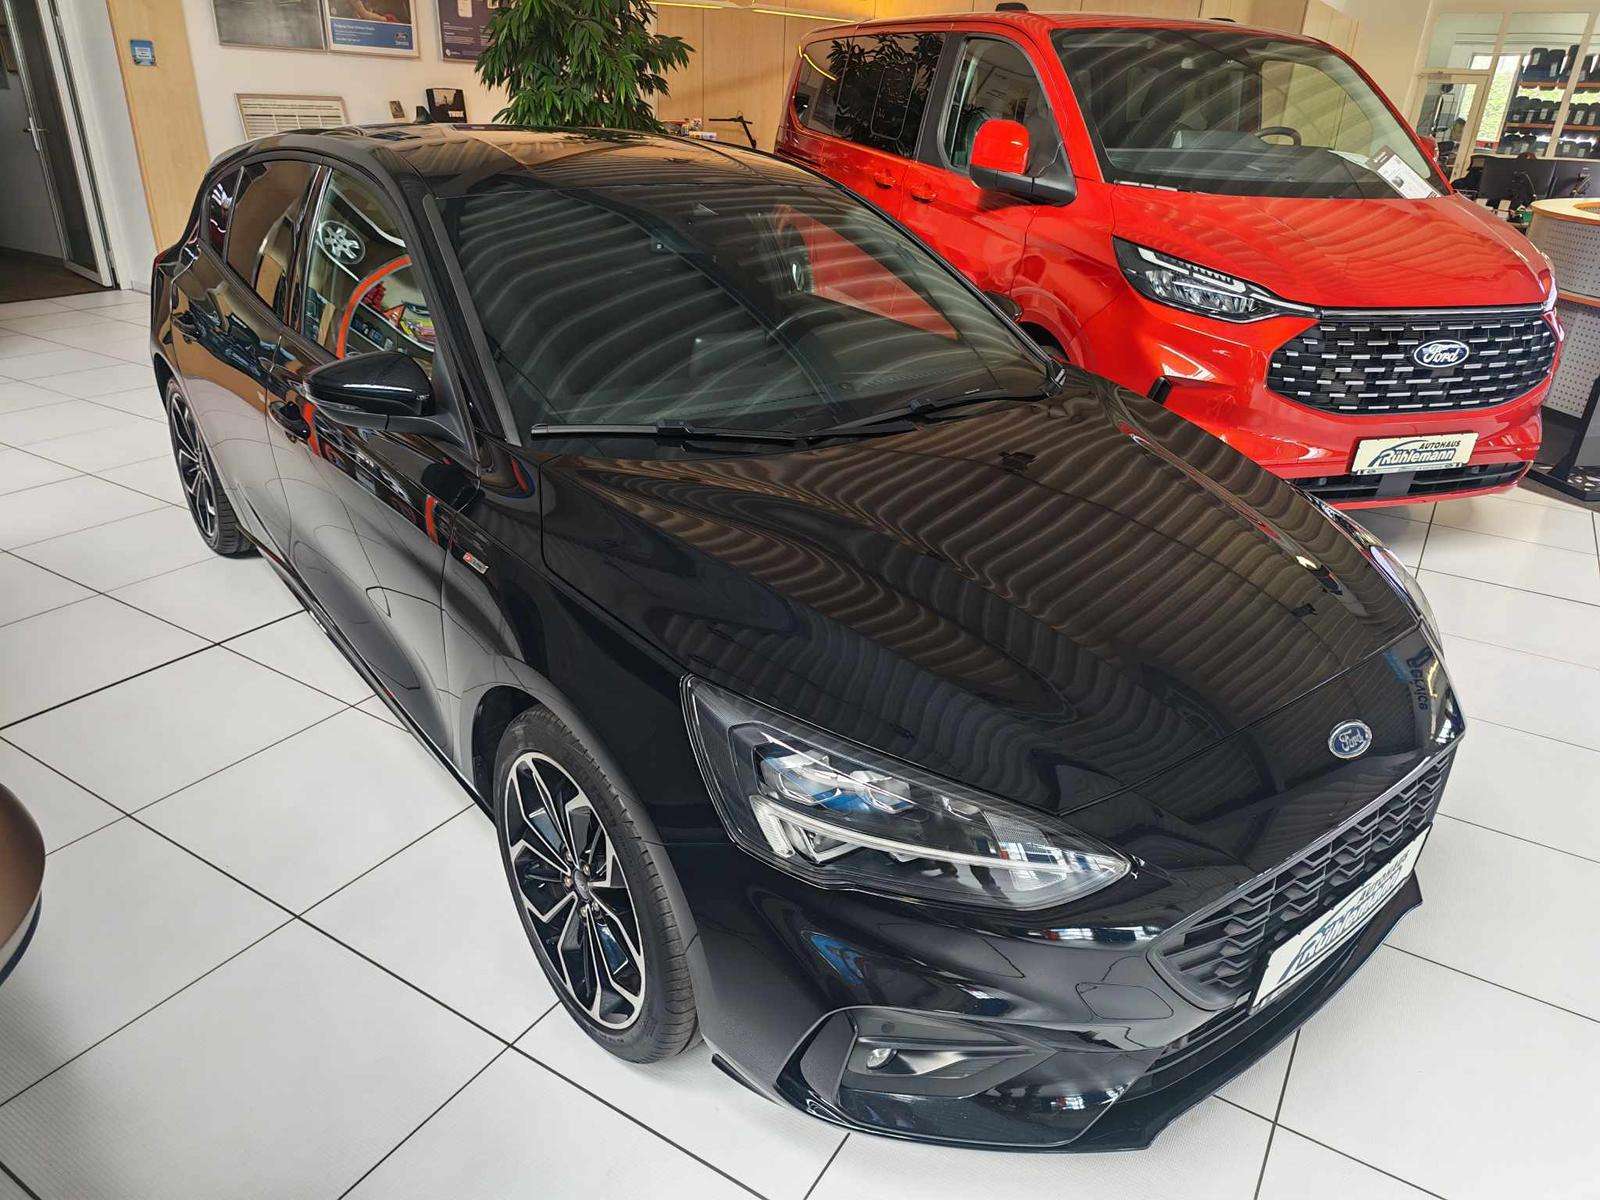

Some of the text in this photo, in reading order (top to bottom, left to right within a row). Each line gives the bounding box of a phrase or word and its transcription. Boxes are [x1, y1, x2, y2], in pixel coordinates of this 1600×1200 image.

[1422, 342, 1462, 364] Ford
[1419, 440, 1461, 450] AUTOHAUS
[1379, 447, 1457, 467] Rühlemann
[1338, 728, 1365, 752] Ford
